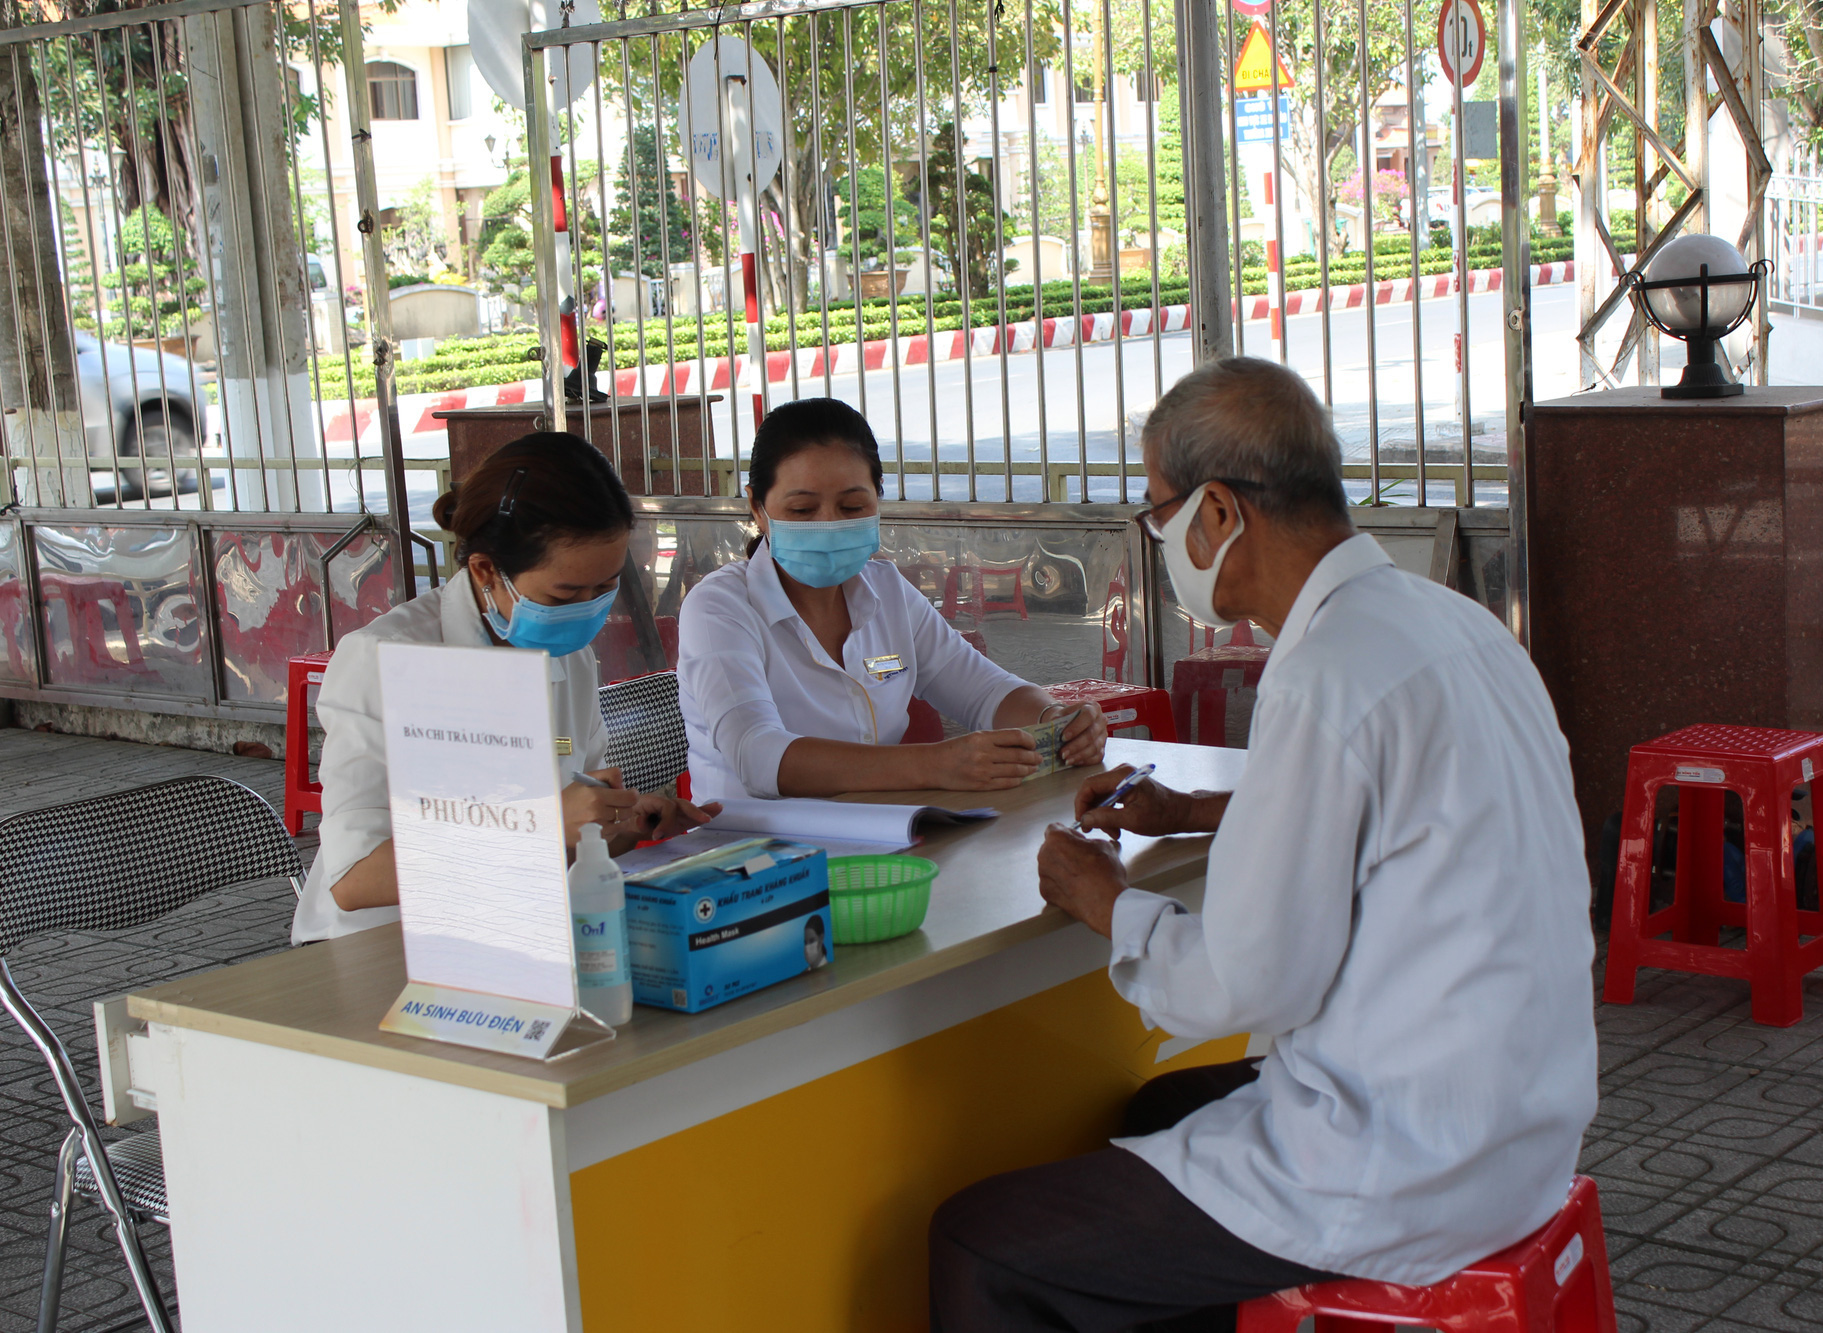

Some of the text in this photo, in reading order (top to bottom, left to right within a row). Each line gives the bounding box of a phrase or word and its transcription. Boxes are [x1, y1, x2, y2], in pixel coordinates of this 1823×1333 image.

[1242, 70, 1251, 80] ĐI
[426, 728, 445, 741] CHI
[470, 732, 508, 747] LƯƠNG
[419, 795, 537, 833] PHƯỜNG 3
[741, 885, 763, 902] TRANG
[581, 921, 606, 937] On1
[695, 927, 740, 946] Health Mask
[400, 1000, 525, 1035] AN SINH BƯU ĐIỆN
